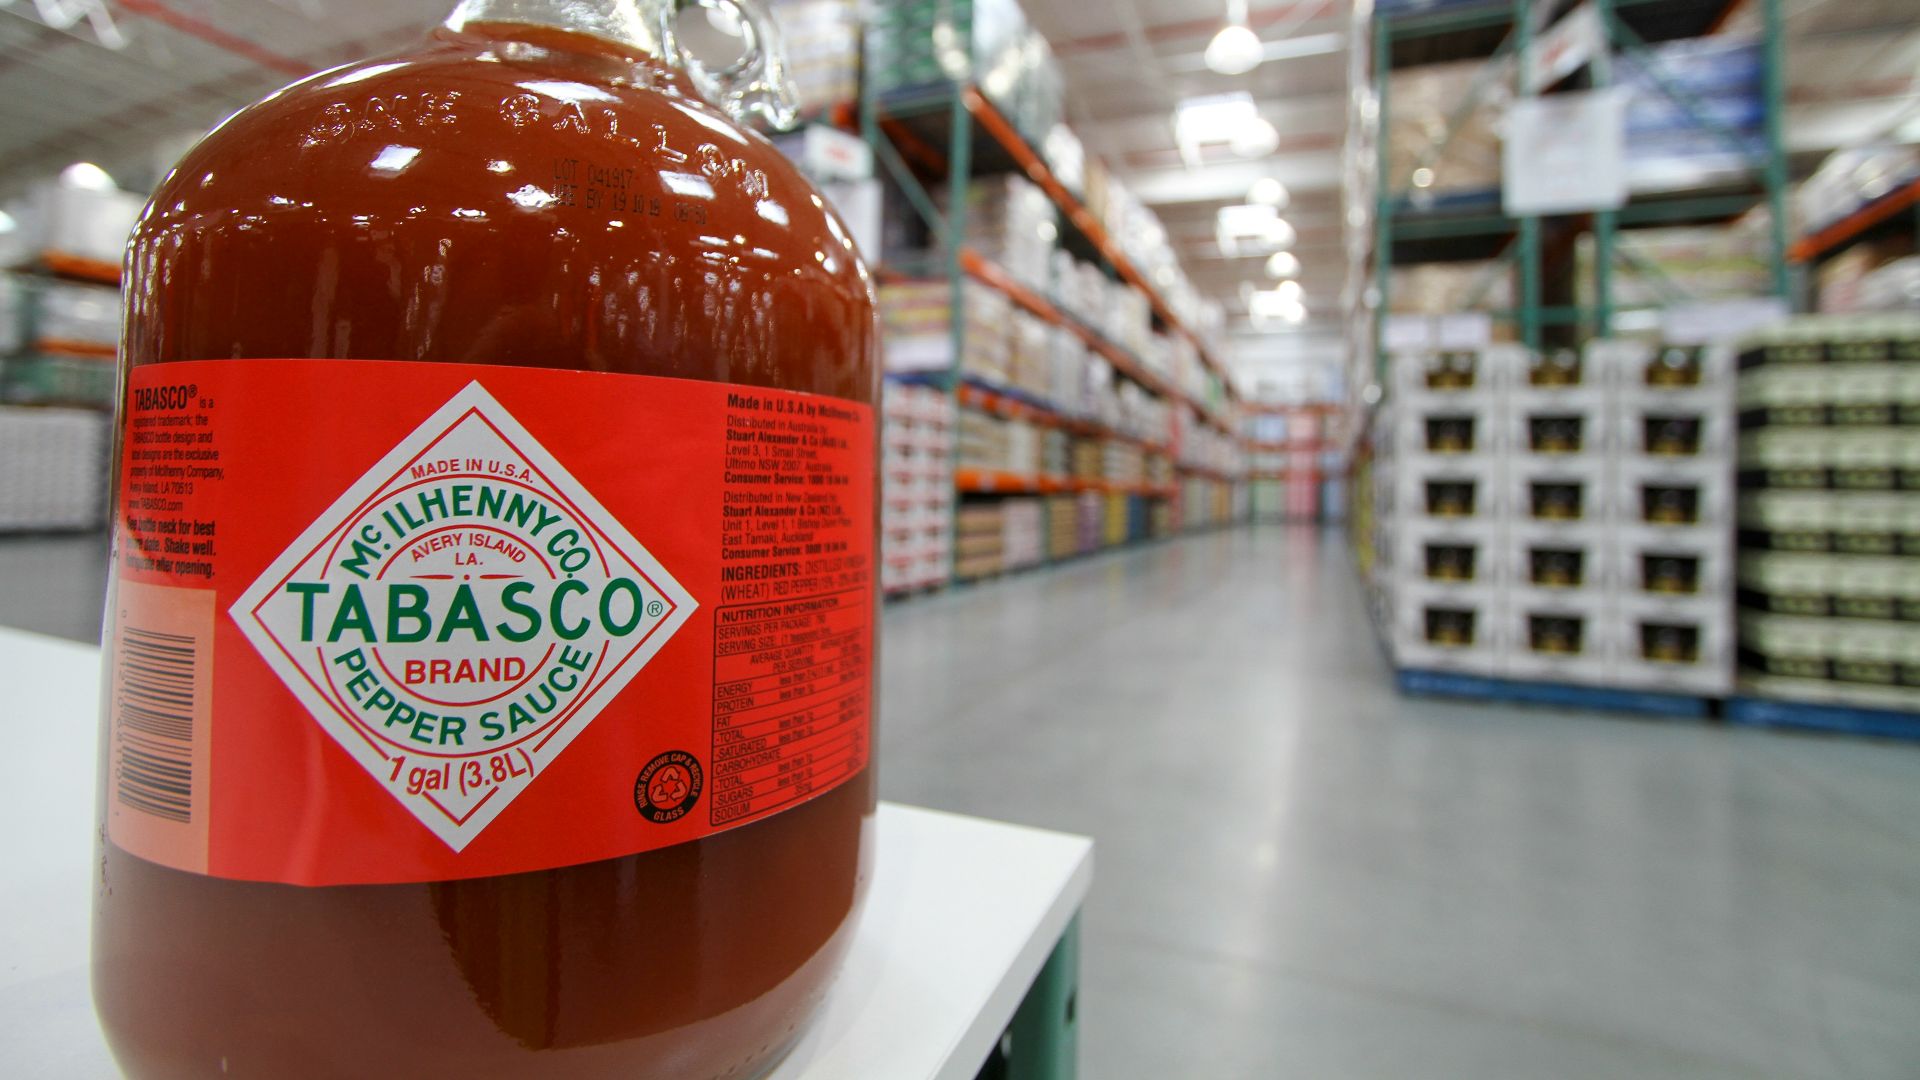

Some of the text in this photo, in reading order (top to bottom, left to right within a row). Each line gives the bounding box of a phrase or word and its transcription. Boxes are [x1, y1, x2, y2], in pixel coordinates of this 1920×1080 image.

[552, 158, 578, 181] LOT
[208, 399, 214, 408] a
[728, 393, 760, 410] Made
[763, 397, 773, 412] in
[806, 402, 816, 418] by
[196, 415, 208, 426] the
[726, 415, 776, 430] Distributed
[778, 420, 785, 430] in
[173, 433, 196, 446] design
[198, 431, 213, 443] and
[726, 428, 756, 442] Stuart
[758, 430, 800, 445] Alexander
[801, 434, 808, 446] &
[185, 450, 219, 460] exclusive
[726, 444, 750, 456] Level
[772, 446, 794, 458] Small
[187, 464, 224, 480] Company,
[410, 458, 535, 484] MADE IN U.S.A.
[724, 458, 756, 470] Ultimo
[758, 458, 780, 470] NSW
[724, 471, 771, 486] Consumer
[161, 482, 170, 494] LA
[724, 490, 772, 504] Distributed
[774, 492, 783, 503] in
[786, 492, 802, 503] New
[722, 505, 752, 518] Stuart
[754, 505, 798, 517] Alexander
[158, 518, 176, 534] neck
[178, 519, 192, 534] for
[193, 518, 216, 536] best
[722, 519, 742, 532] Unit
[756, 518, 778, 531] Level
[722, 532, 742, 546] East
[164, 538, 190, 554] Shake
[192, 539, 217, 557] well.
[410, 533, 527, 564] AVERY ISLAND
[722, 547, 770, 560] Consumer
[454, 552, 484, 566] LA.
[175, 560, 216, 580] opening.
[721, 560, 802, 582] INGREDIENTS:
[720, 582, 770, 605] (WHEAT)
[773, 580, 789, 596] RED
[722, 598, 840, 622] NUTRITION INFORMATION
[718, 625, 762, 640] SERVINGS
[764, 622, 779, 633] PER
[780, 616, 811, 631] PACKAGE
[718, 640, 756, 655] SERVING
[758, 636, 776, 650] SIZE
[750, 652, 782, 666] AVERAGE
[772, 660, 788, 673] PER
[404, 657, 526, 685] BRAND
[334, 645, 593, 746] PEPPER SAUCE
[717, 682, 752, 698] ENERGY
[716, 697, 754, 714] PROTEIN
[716, 716, 732, 728] FAT
[670, 754, 687, 762] CAP
[684, 758, 692, 766] &
[716, 748, 782, 776] CARBOHYDRATE
[389, 748, 536, 797] 1 gal (3.8L)
[640, 754, 670, 782] REMOVE
[636, 783, 649, 808] RINSE
[654, 806, 685, 821] GLASS
[714, 802, 750, 822] SODIUM
